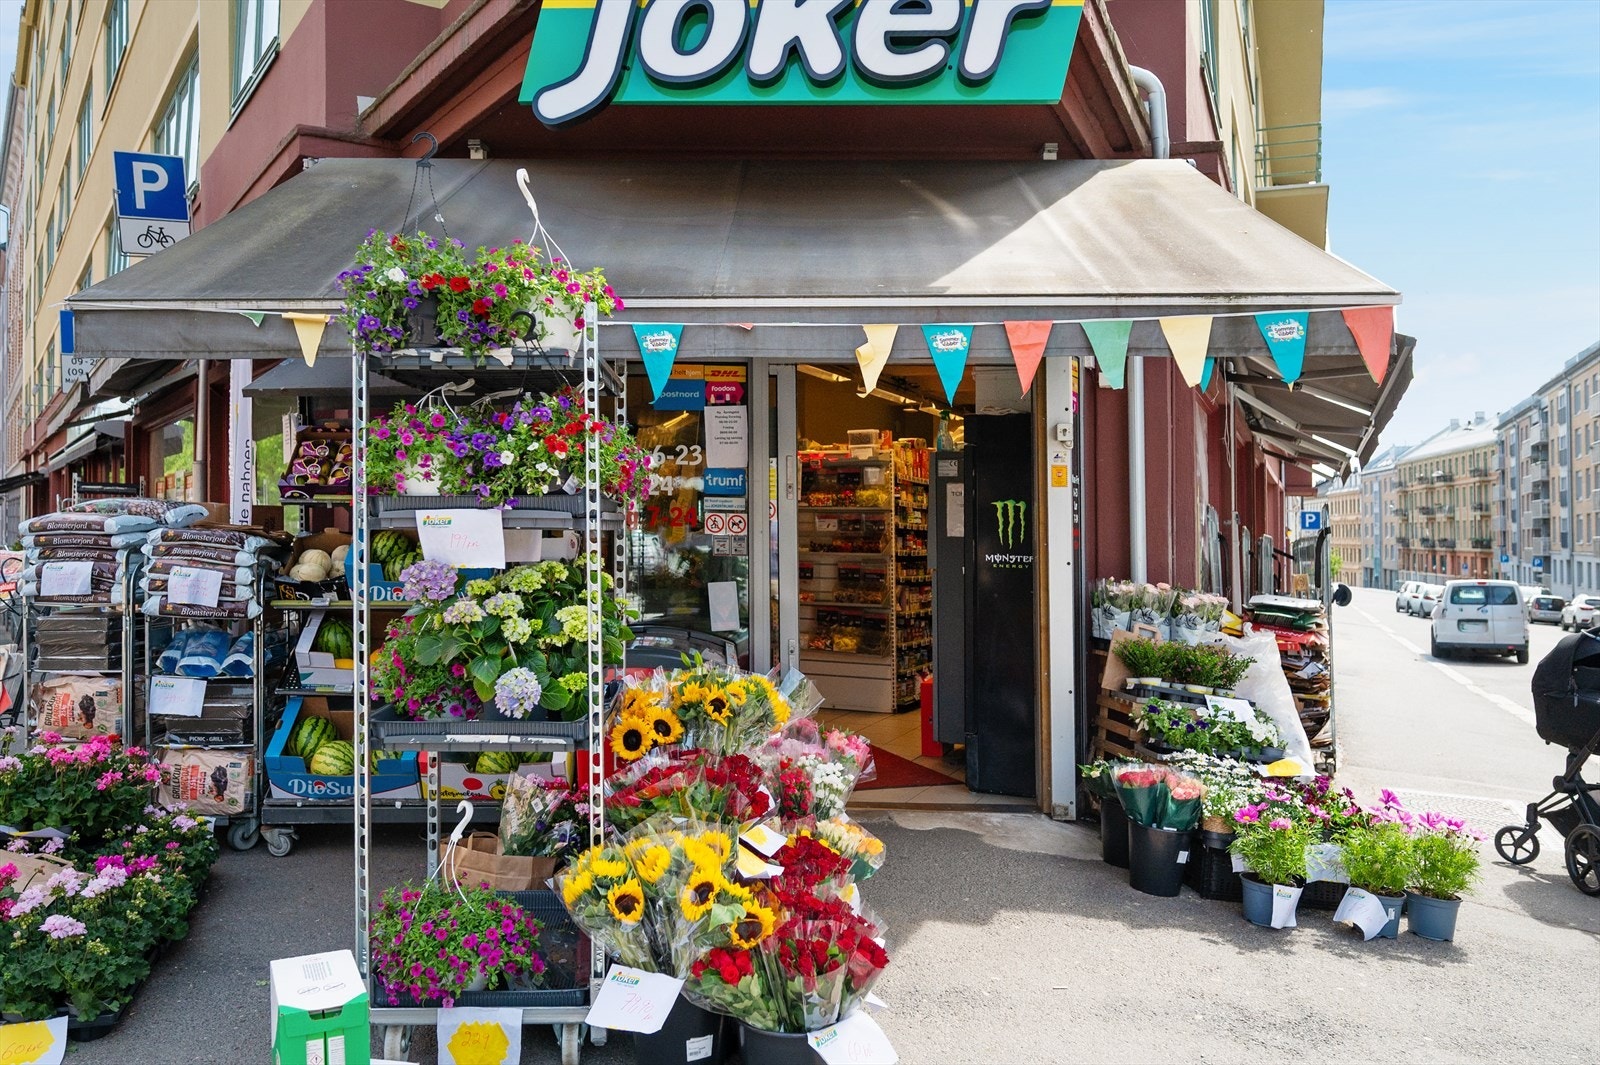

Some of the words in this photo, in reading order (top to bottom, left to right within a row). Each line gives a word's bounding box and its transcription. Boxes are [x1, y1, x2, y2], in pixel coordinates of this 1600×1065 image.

[132, 161, 169, 209] P
[706, 474, 744, 487] trumf
[647, 506, 698, 528] 7-24
[1305, 513, 1316, 526] P
[47, 521, 88, 530] Blomsterjord
[53, 537, 94, 545] Blomsterjord
[181, 533, 228, 543] Blomsterjord
[171, 547, 217, 558] Blomsterjord
[181, 608, 228, 618] Blomsterjord
